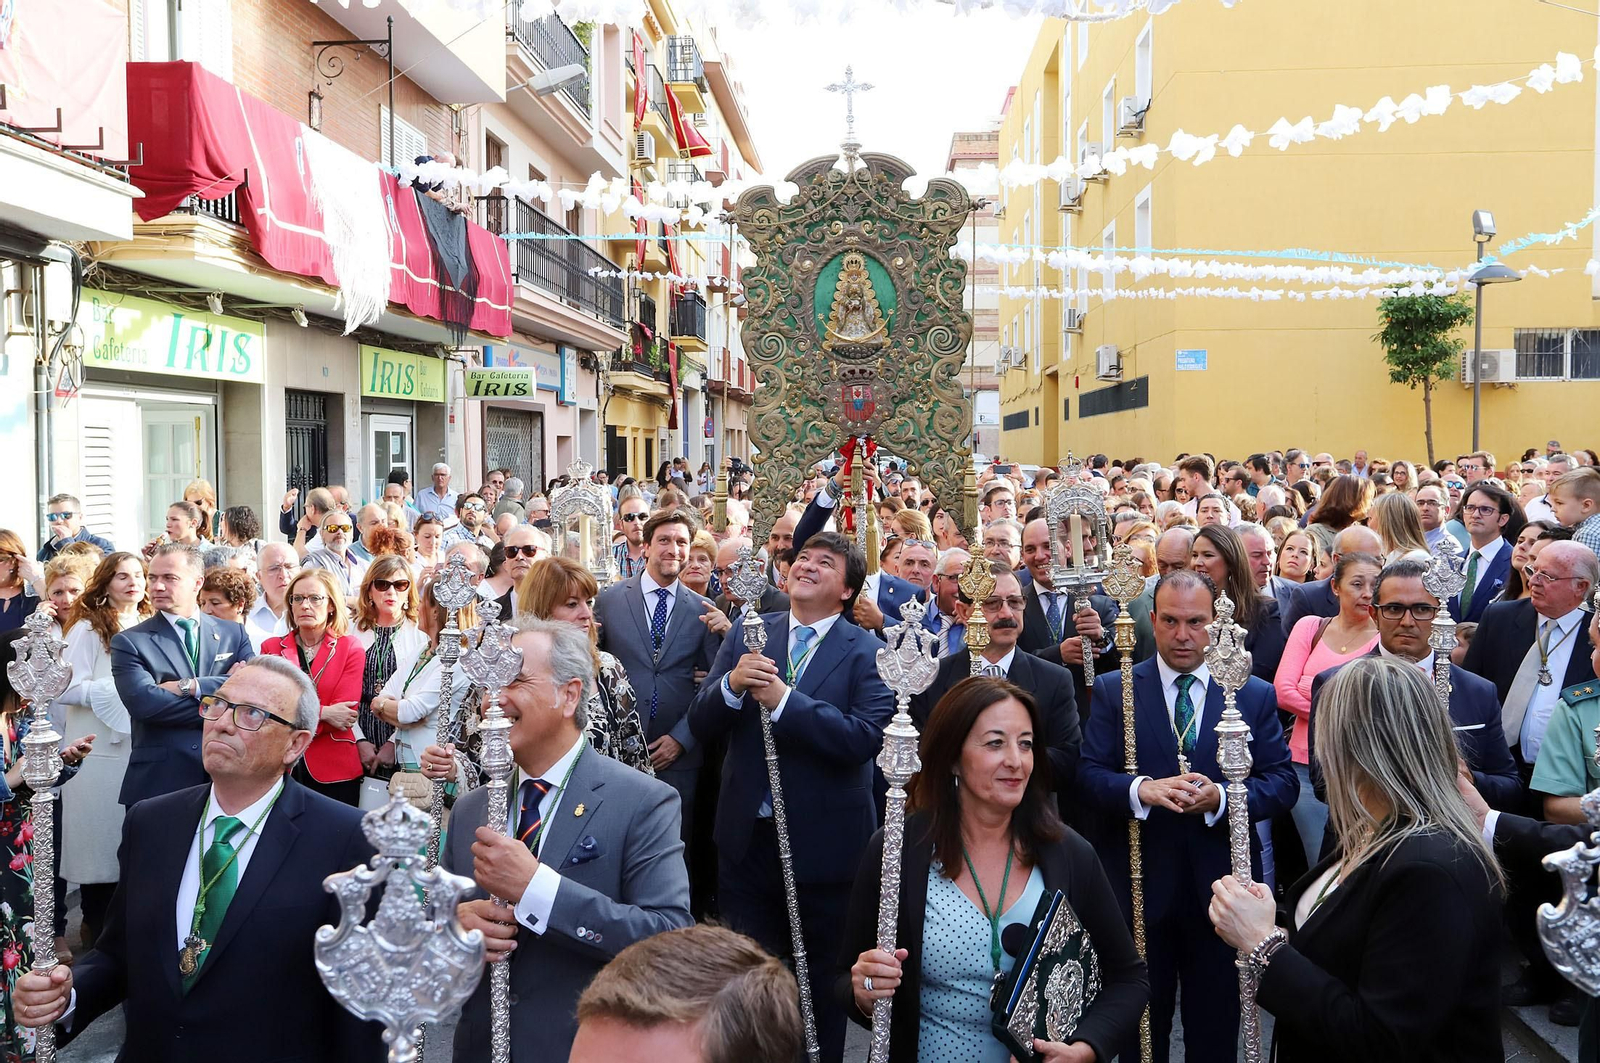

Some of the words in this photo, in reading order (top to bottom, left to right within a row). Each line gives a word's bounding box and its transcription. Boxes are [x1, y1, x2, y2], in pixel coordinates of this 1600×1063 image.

[165, 312, 252, 375] IRIS
[369, 352, 415, 396] IRIS
[470, 371, 486, 380] Bar
[473, 380, 528, 397] IRIS
